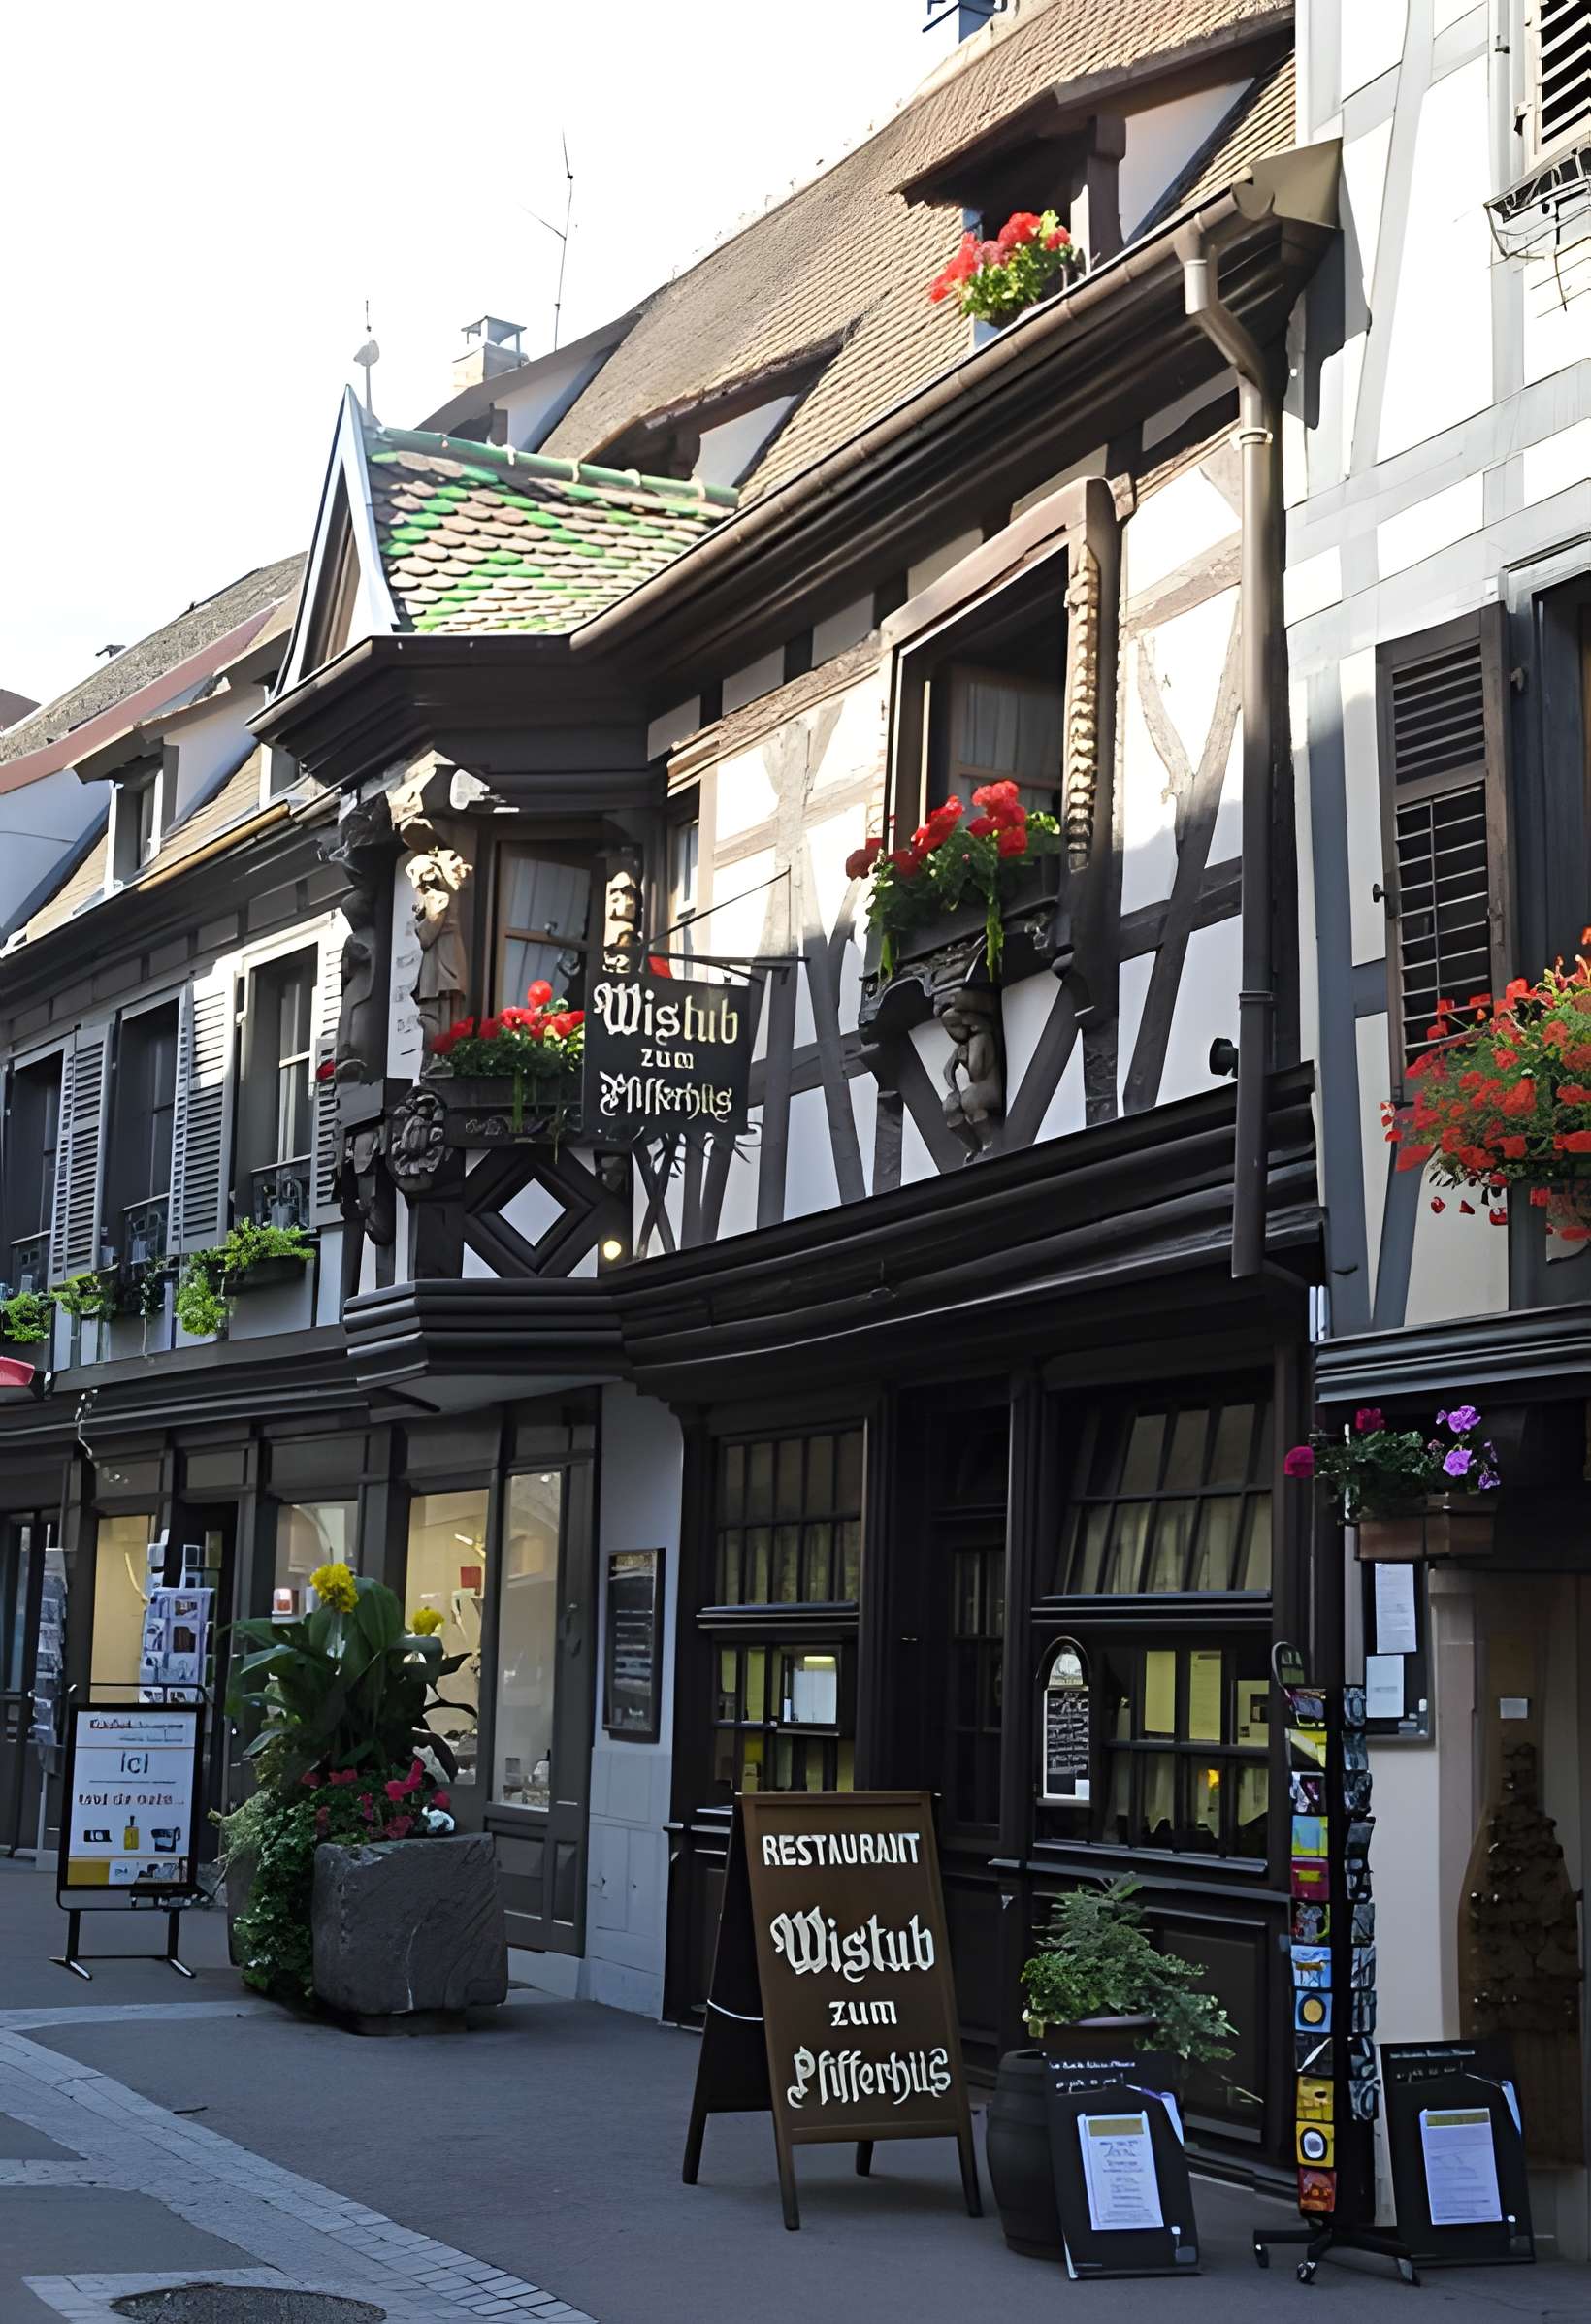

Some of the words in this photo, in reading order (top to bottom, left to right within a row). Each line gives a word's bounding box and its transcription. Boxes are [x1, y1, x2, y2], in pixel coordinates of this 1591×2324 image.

[640, 1049, 695, 1070] zum
[762, 1832, 920, 1866] RESTAURANT
[828, 2000, 898, 2027] zum
